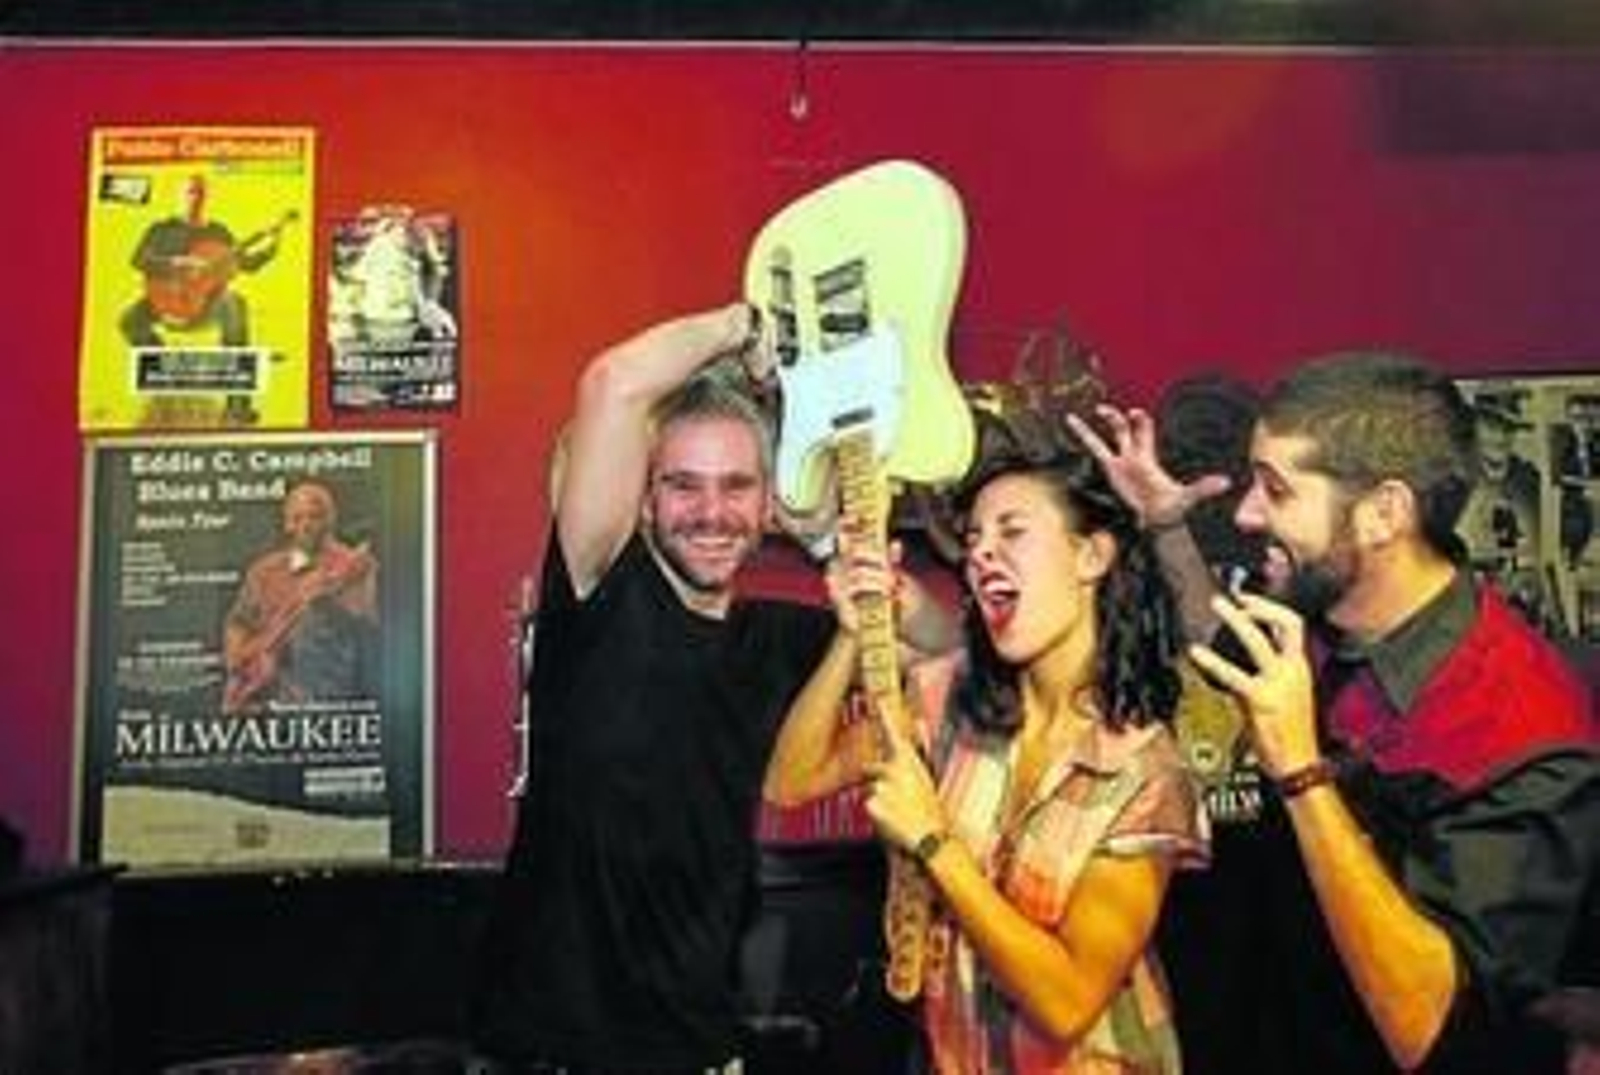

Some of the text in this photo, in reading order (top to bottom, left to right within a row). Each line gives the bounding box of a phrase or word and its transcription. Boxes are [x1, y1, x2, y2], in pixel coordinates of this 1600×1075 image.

[131, 447, 372, 475] Eddie C. Campbell
[139, 477, 287, 504] Blues Band
